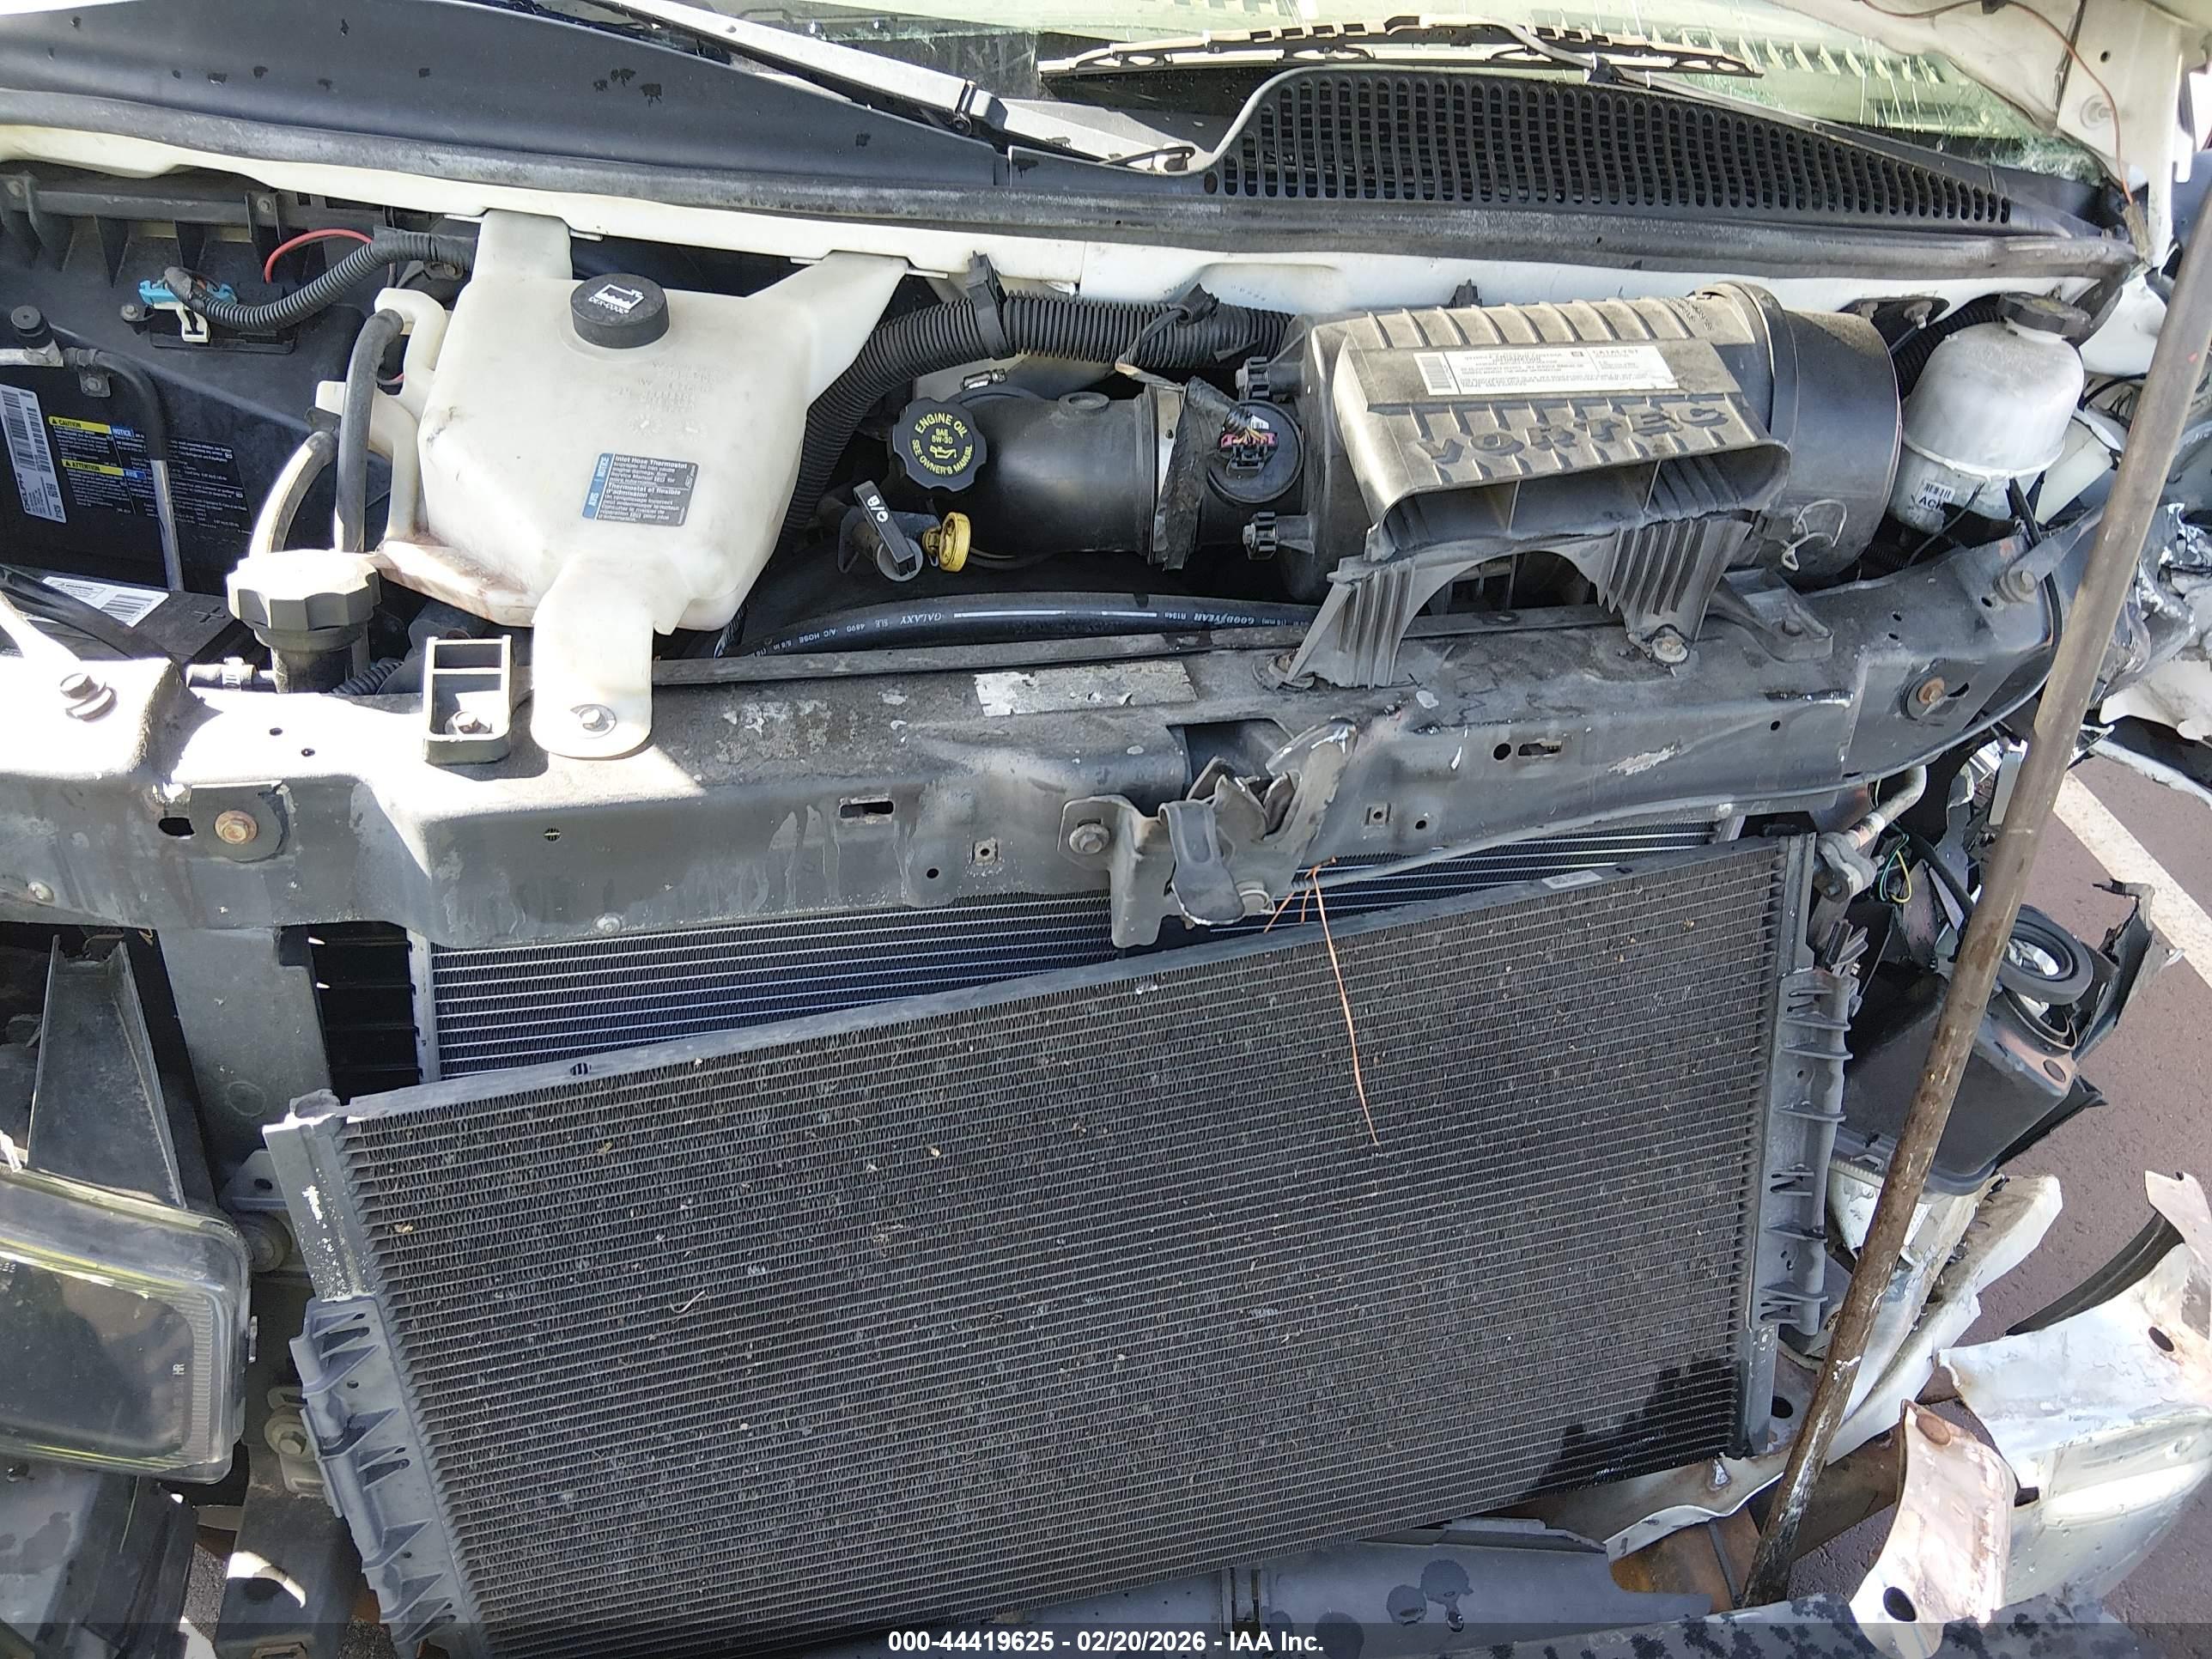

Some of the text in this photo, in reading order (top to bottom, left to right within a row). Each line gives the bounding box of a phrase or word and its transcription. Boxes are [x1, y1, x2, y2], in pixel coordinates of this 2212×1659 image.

[58, 419, 82, 428] CAUTION
[915, 412, 968, 439] ENGINE OIL
[112, 428, 131, 436] NOTICE
[1415, 405, 1729, 464] VORTEC
[932, 435, 953, 444] 5W-30
[912, 439, 972, 475] SEE OWNER'S MANUAL
[72, 462, 100, 471] ATTENTION
[650, 459, 688, 469] Thermostat
[608, 483, 647, 492] Thermostat
[875, 618, 889, 628] SLE
[900, 612, 942, 625] GALAXY
[1194, 612, 1255, 625] GOODYEAR
[823, 628, 836, 637] A/C
[799, 634, 820, 644] HOSE
